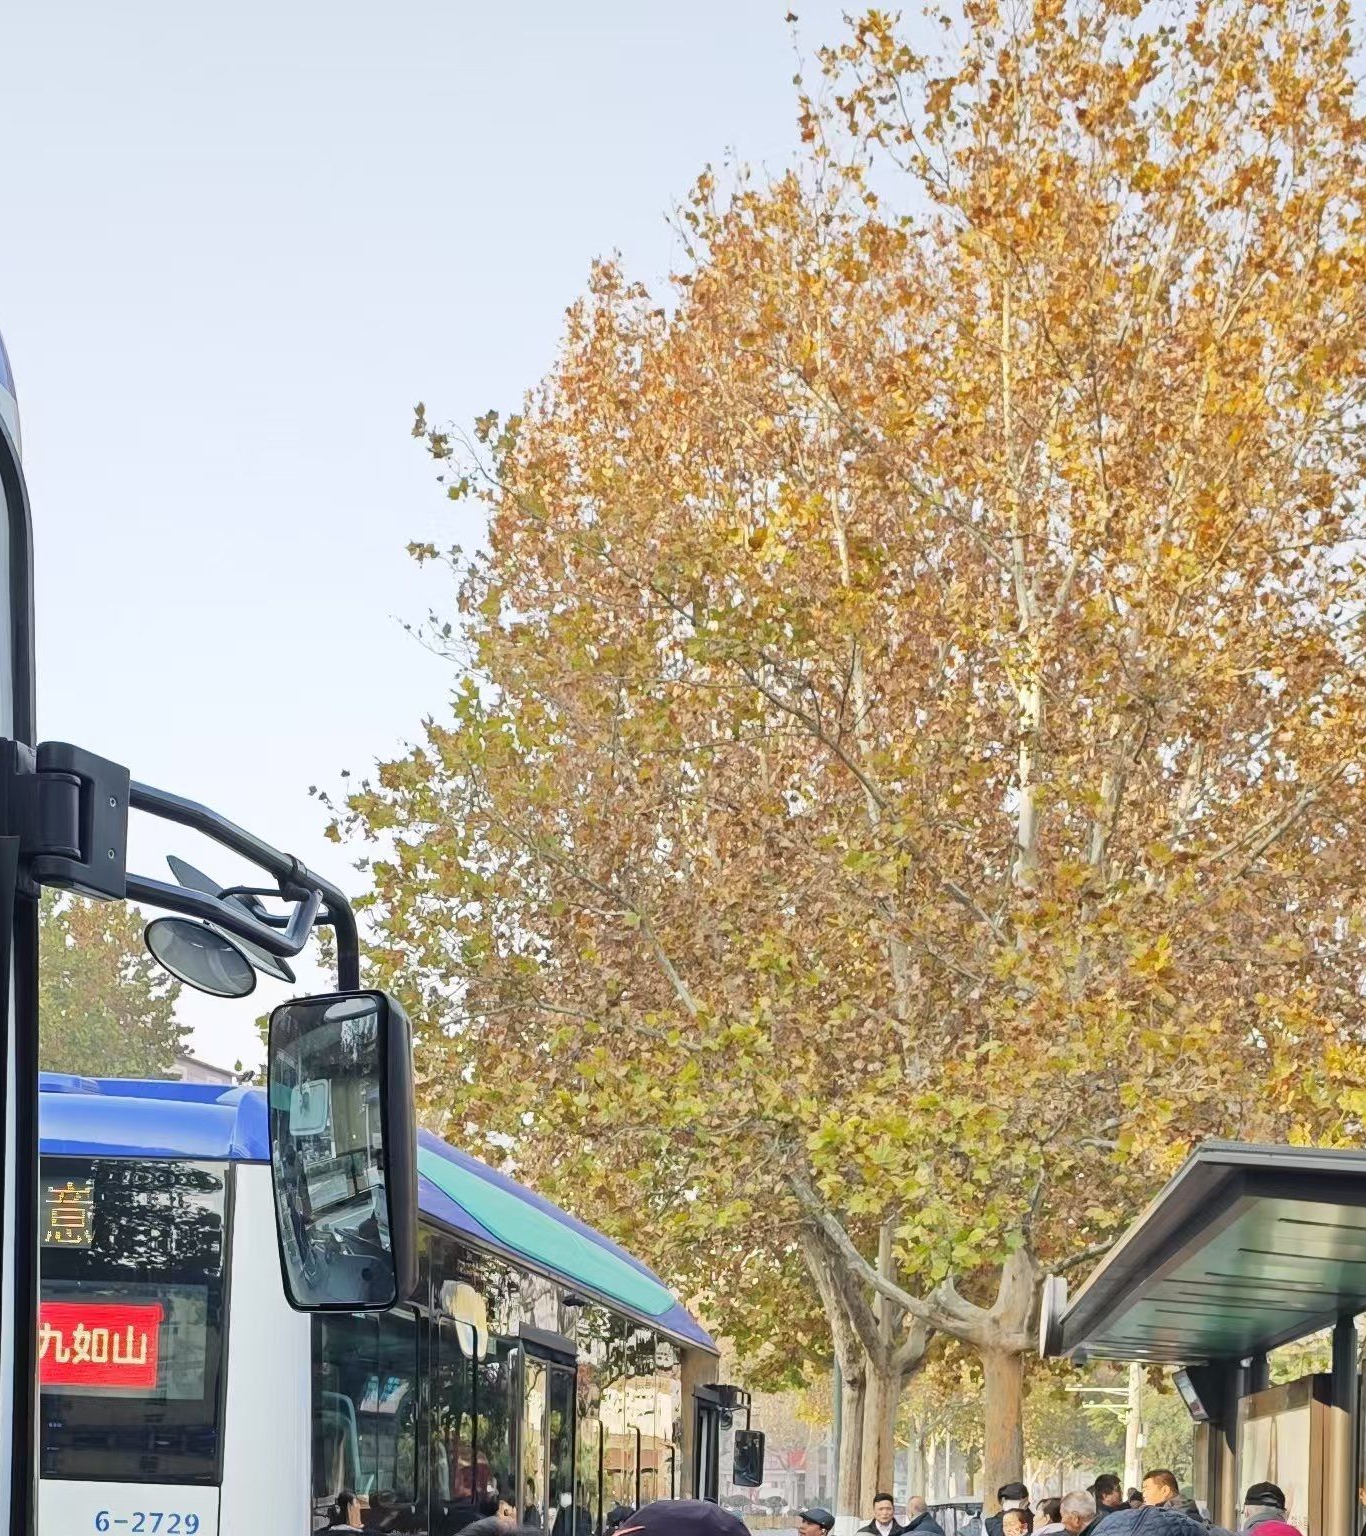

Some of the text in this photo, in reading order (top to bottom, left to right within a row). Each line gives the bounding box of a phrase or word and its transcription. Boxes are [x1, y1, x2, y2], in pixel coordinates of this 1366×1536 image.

[39, 1322, 148, 1364] 九如山
[94, 1510, 201, 1535] 6-2729
